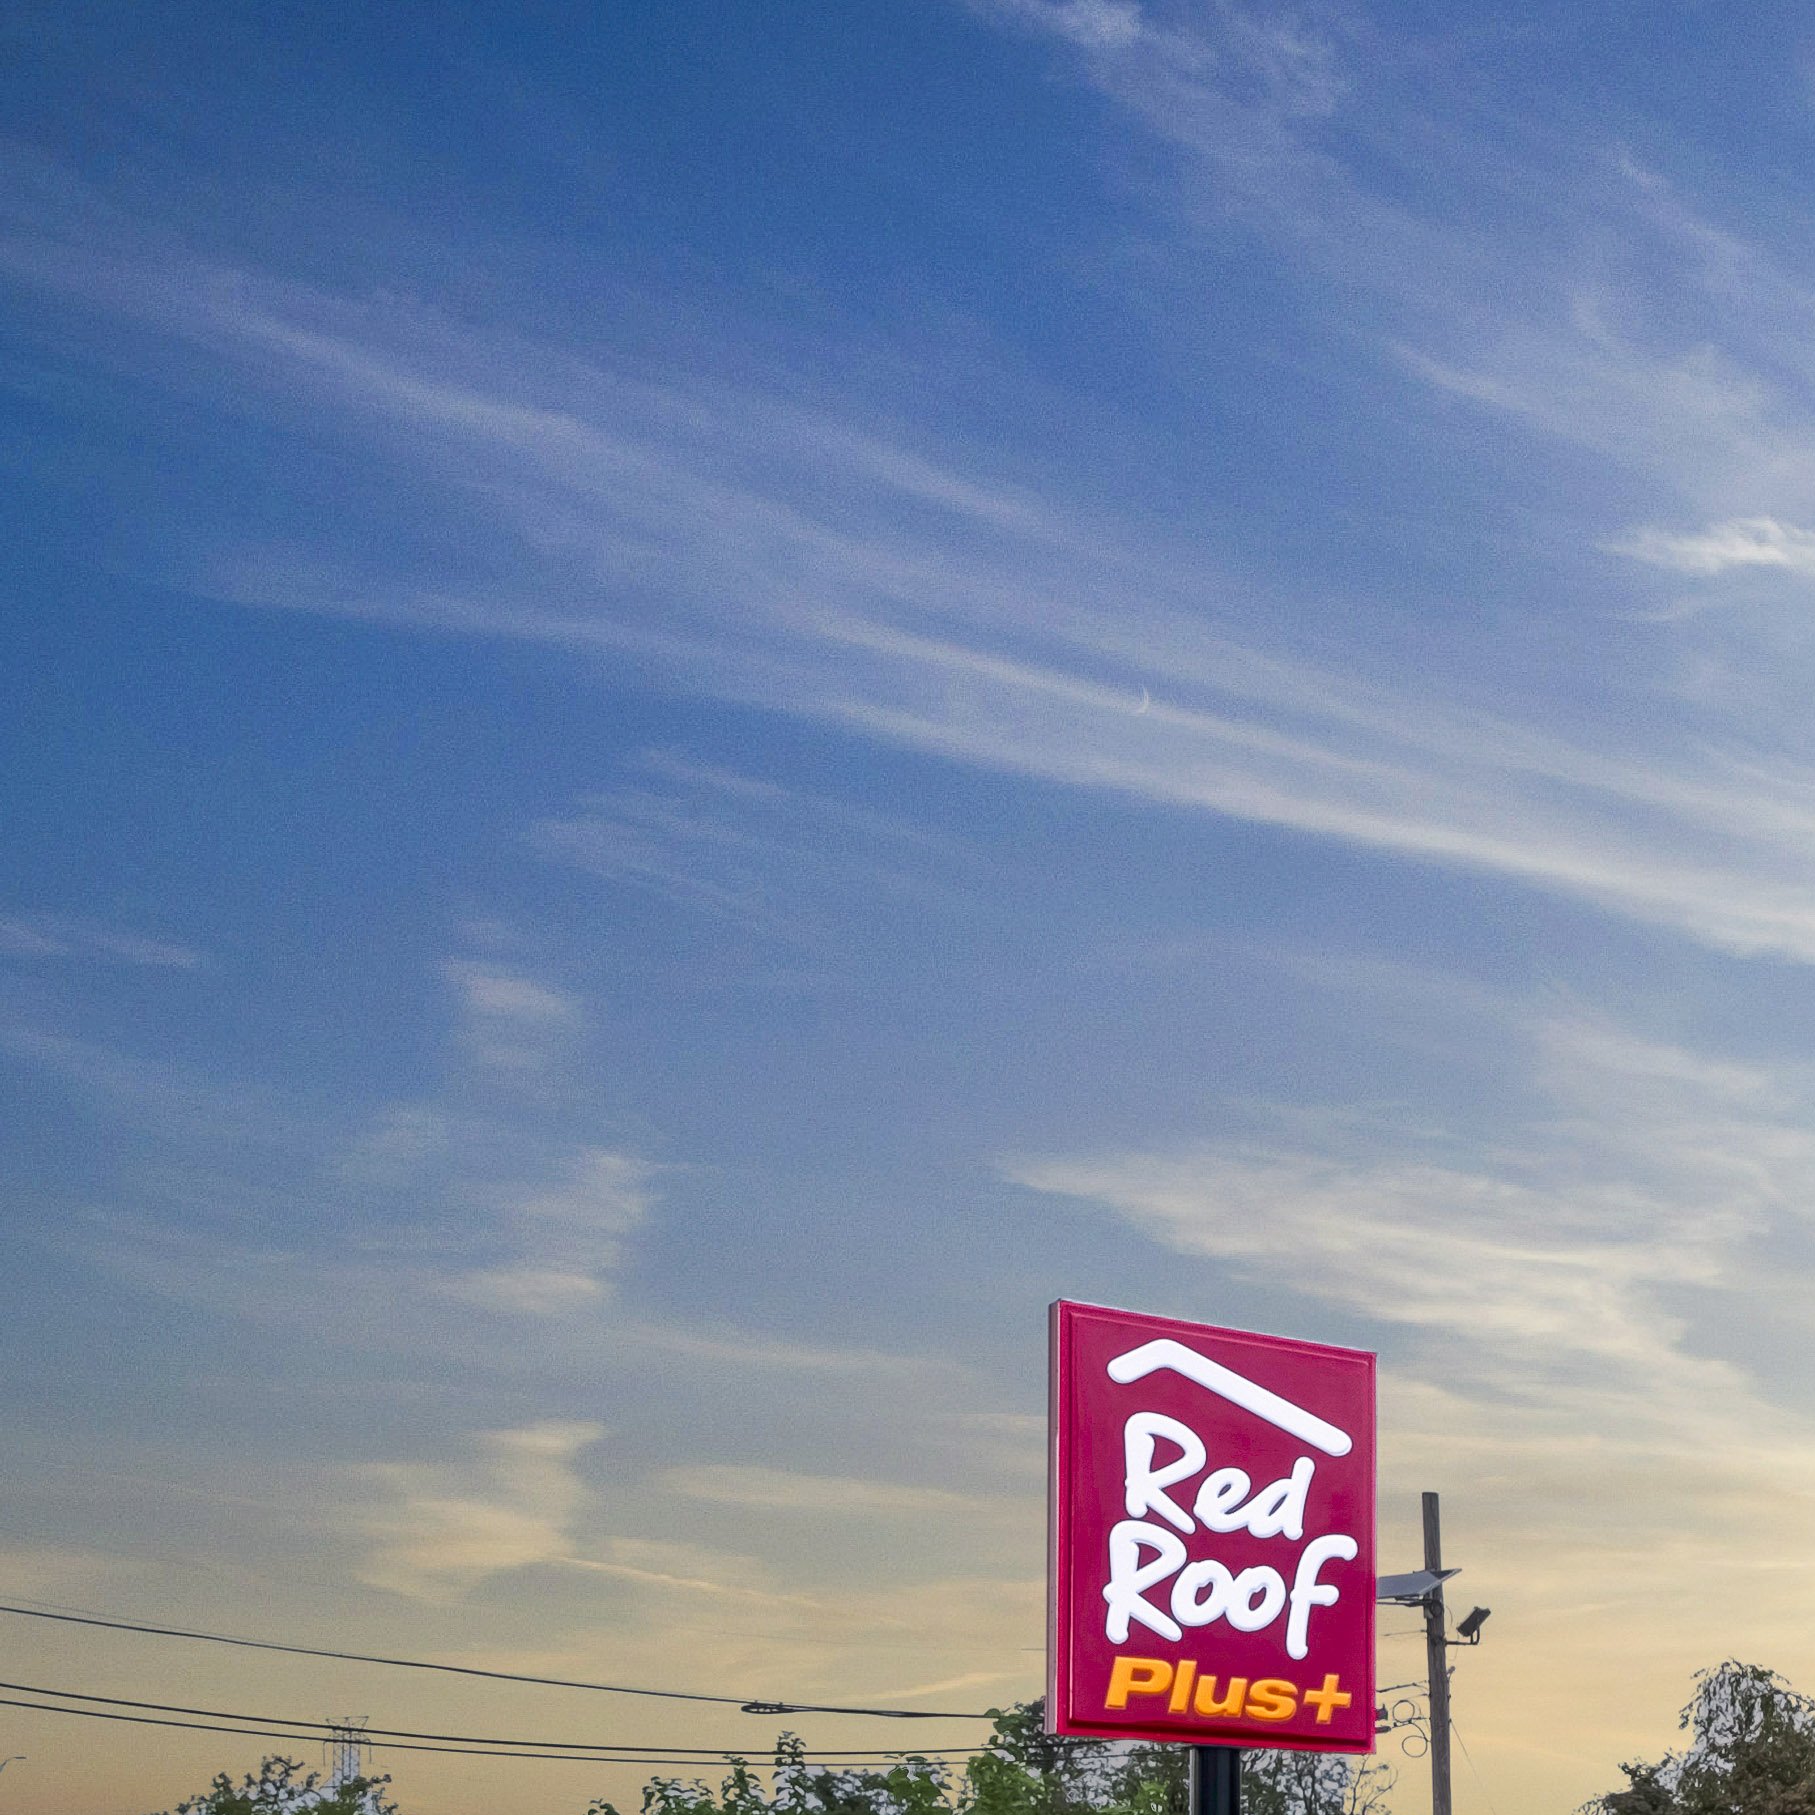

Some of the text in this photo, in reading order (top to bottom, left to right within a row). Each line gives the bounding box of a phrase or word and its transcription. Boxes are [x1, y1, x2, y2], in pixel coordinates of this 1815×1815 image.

[1123, 1411, 1316, 1541] Red
[1102, 1519, 1359, 1661] Roof
[1104, 1655, 1352, 1725] Plus+
